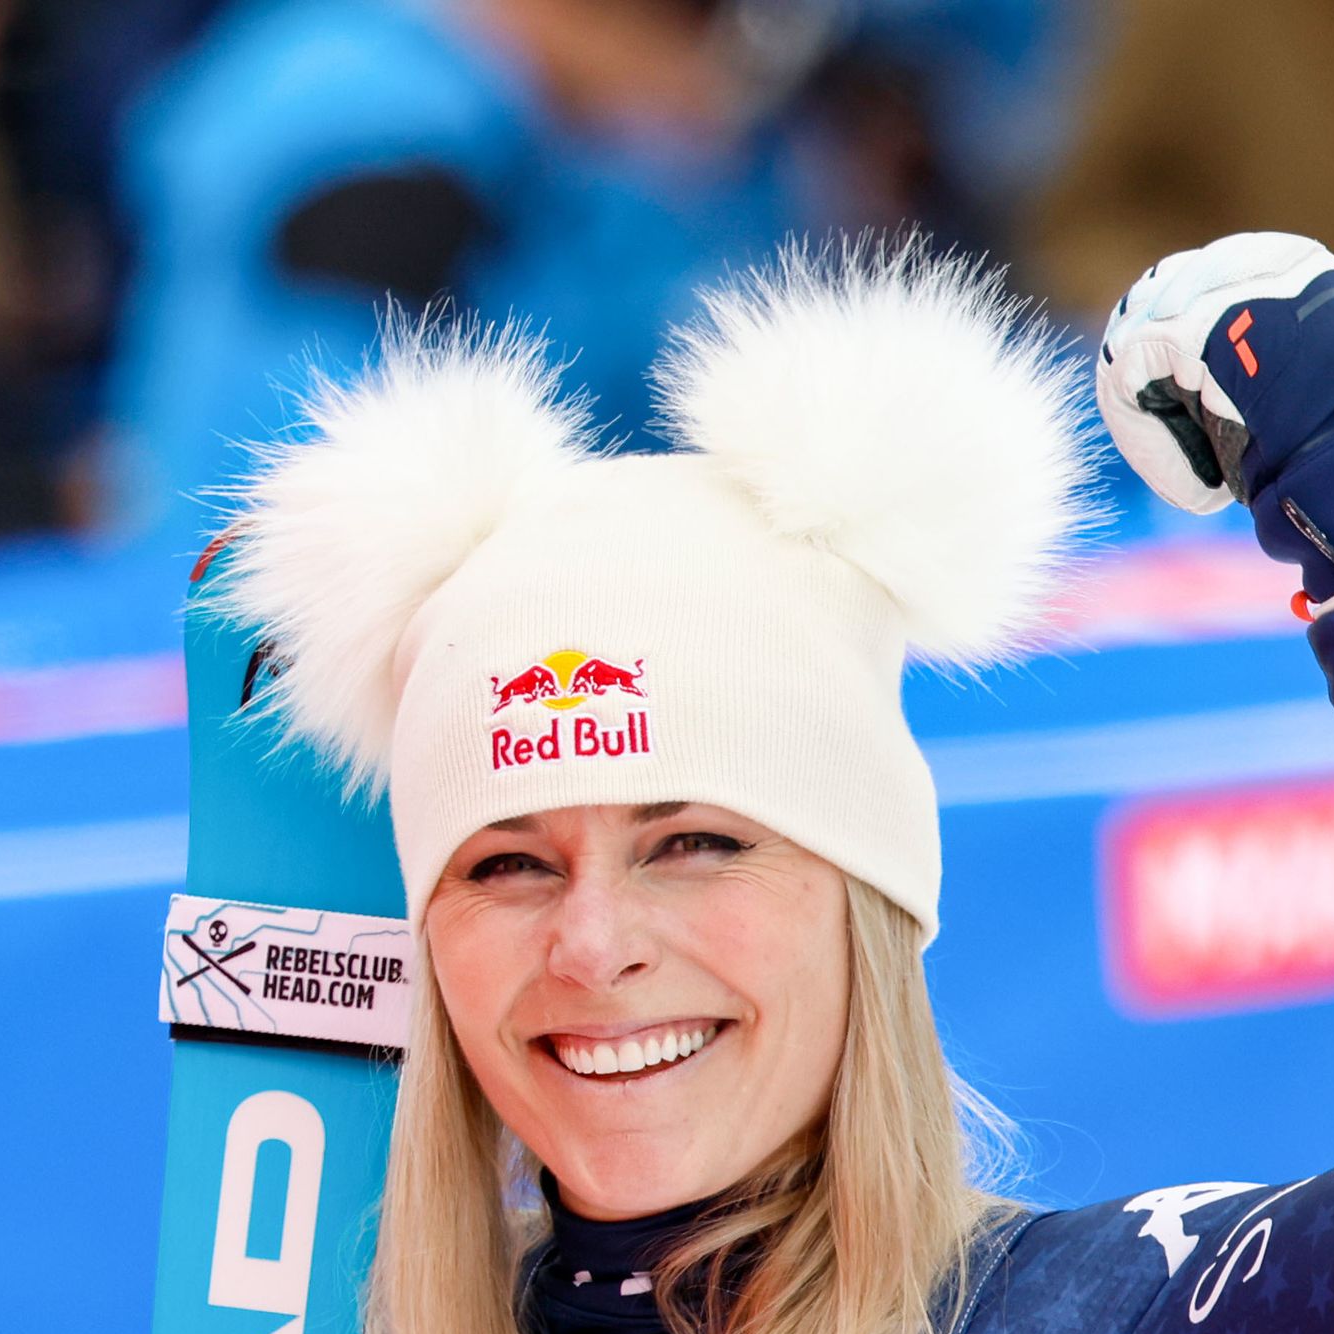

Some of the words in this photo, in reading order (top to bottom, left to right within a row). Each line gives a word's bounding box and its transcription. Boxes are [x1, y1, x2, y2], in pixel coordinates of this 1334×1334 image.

[491, 717, 560, 771] Red
[574, 710, 650, 757] Bull
[263, 973, 375, 1010] HEAD.COM
